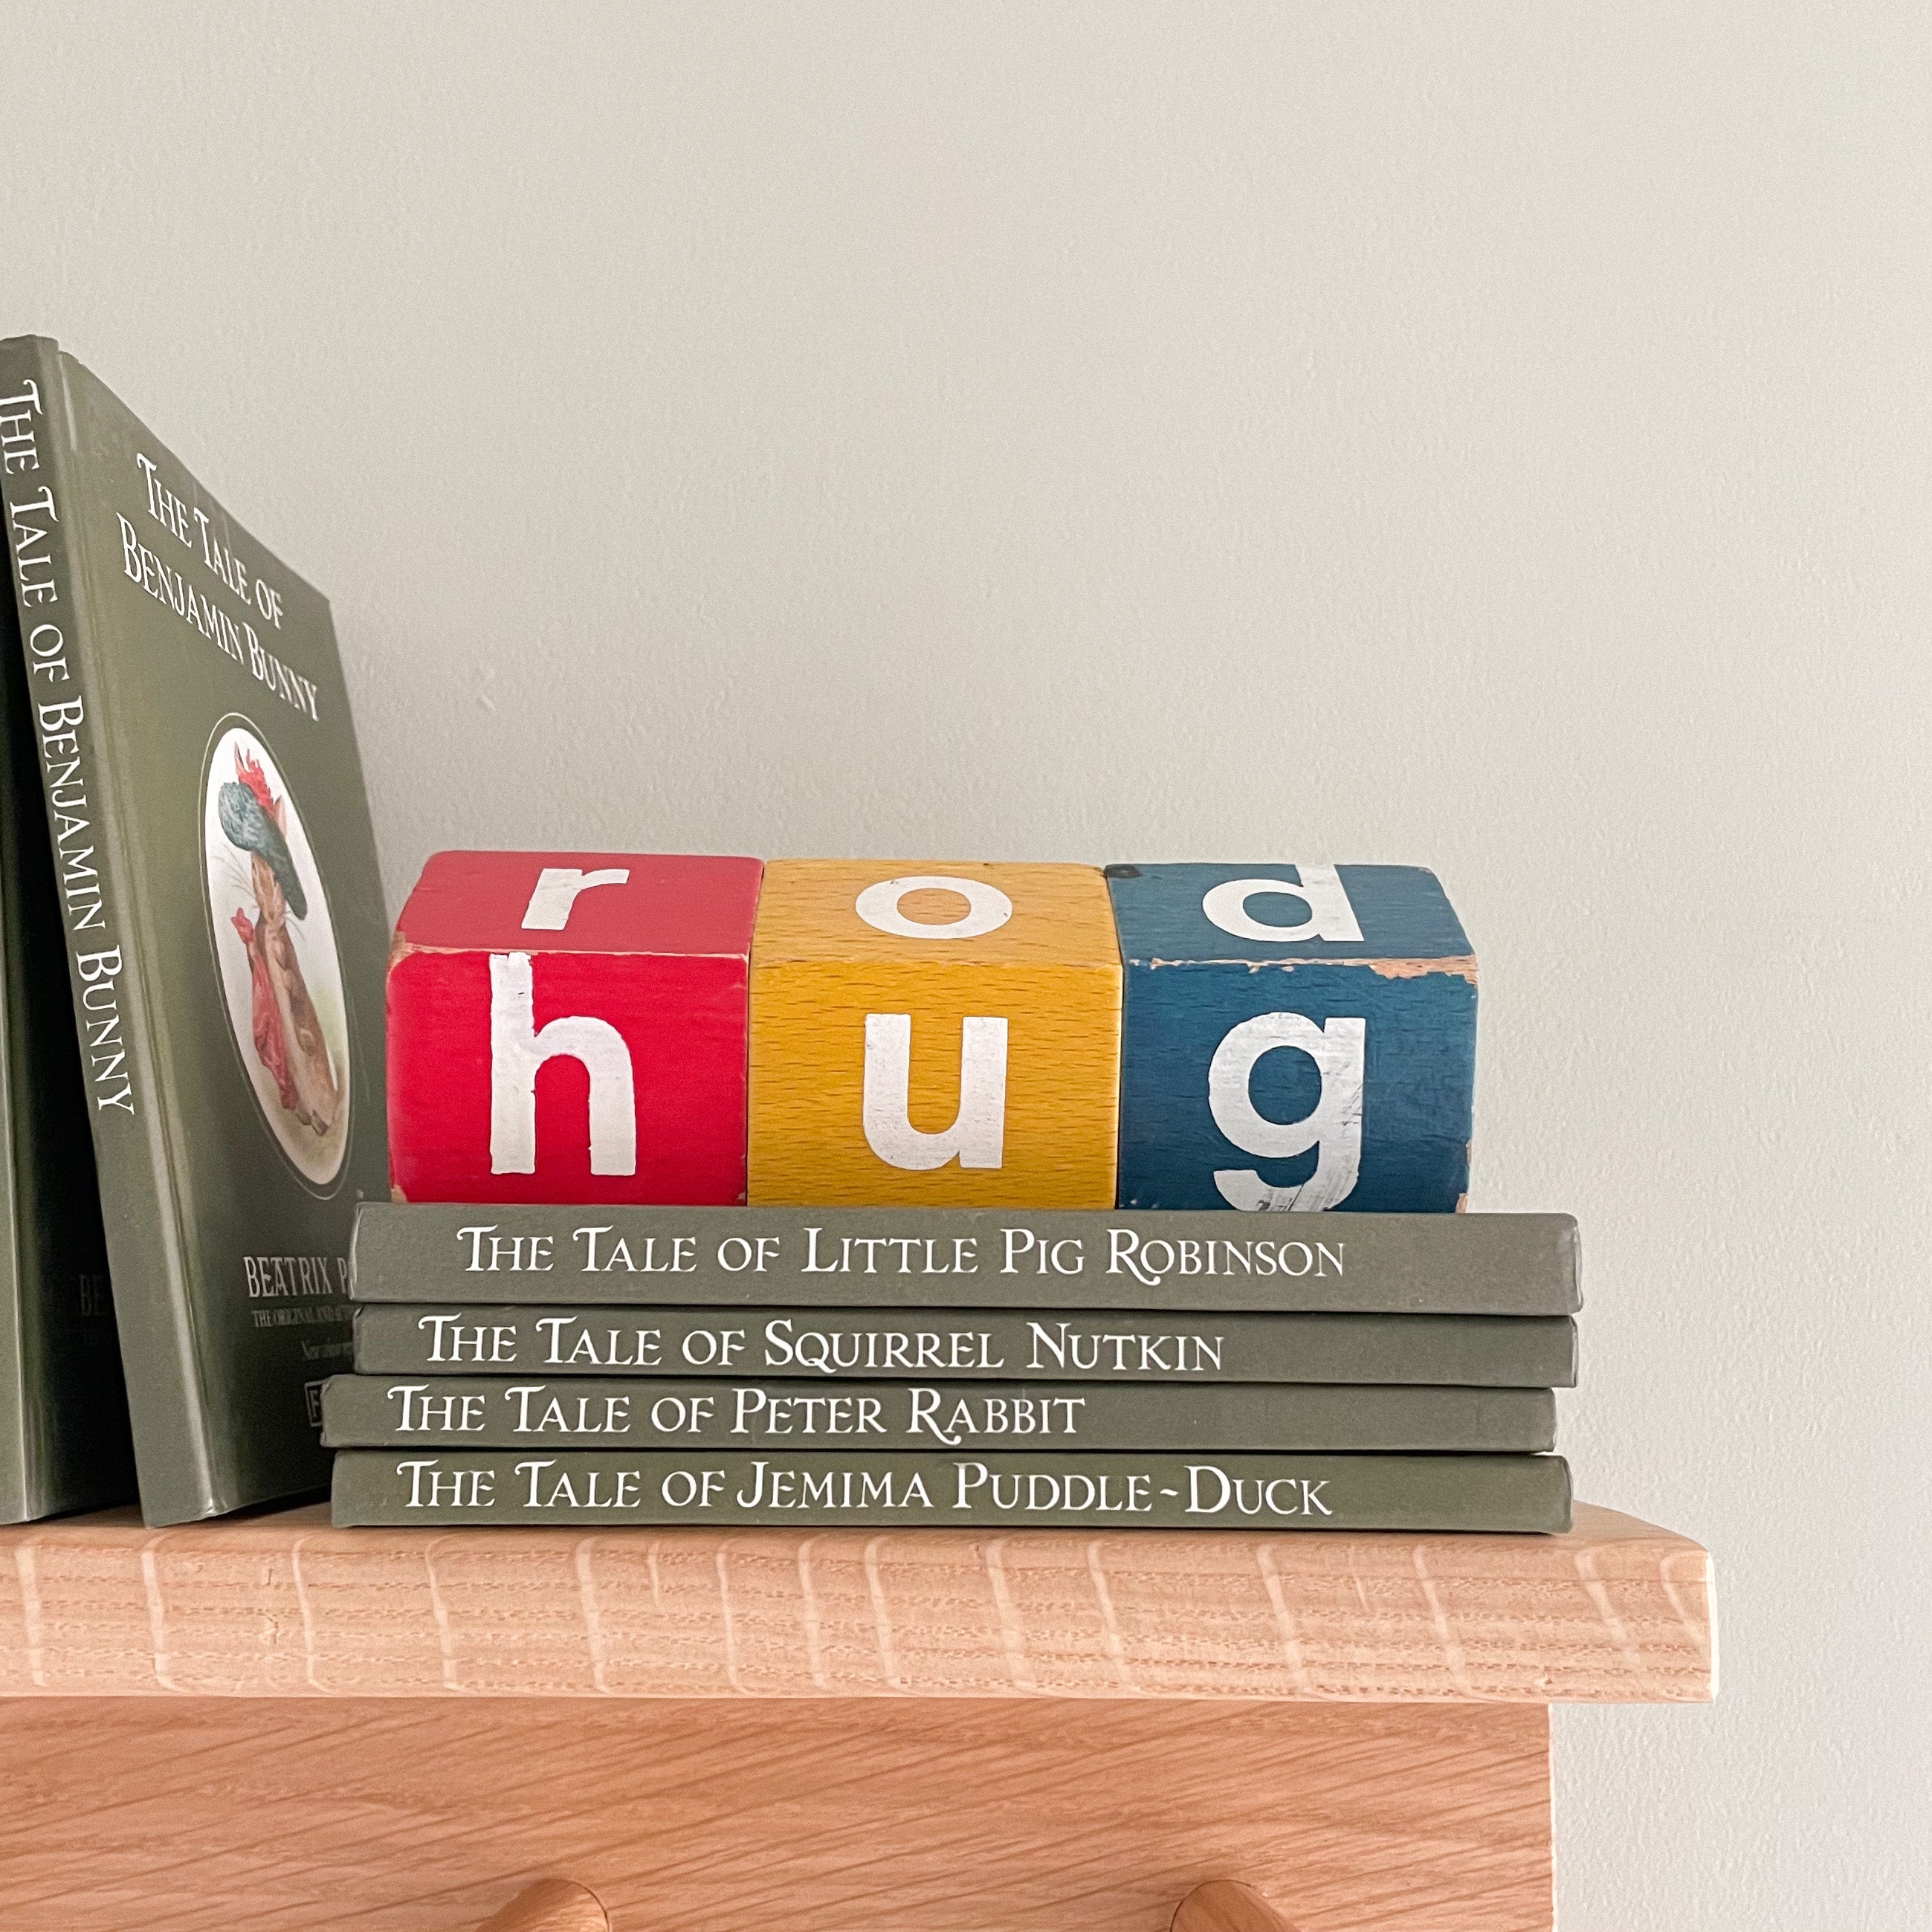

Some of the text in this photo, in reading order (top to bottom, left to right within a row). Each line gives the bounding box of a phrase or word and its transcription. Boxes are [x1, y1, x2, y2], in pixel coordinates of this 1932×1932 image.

[137, 453, 284, 630] THE TALE OF
[116, 511, 319, 722] BENJAMIN BUNNY
[0, 379, 135, 1115] THE TALE OF BENJAMIN BUNNY
[243, 1256, 333, 1297] BEATRIX
[456, 1224, 1345, 1287] THE TALE OF LITTLE PIG ROBINSON
[418, 1313, 1224, 1374] THE TALE OF SQUIRREL NUTKIN
[387, 1384, 1086, 1446] THE TALE OF PETER RABBIT
[396, 1459, 496, 1508] THE
[514, 1460, 642, 1508] TALE
[662, 1470, 726, 1508] OF
[737, 1461, 934, 1509] JEMIMA
